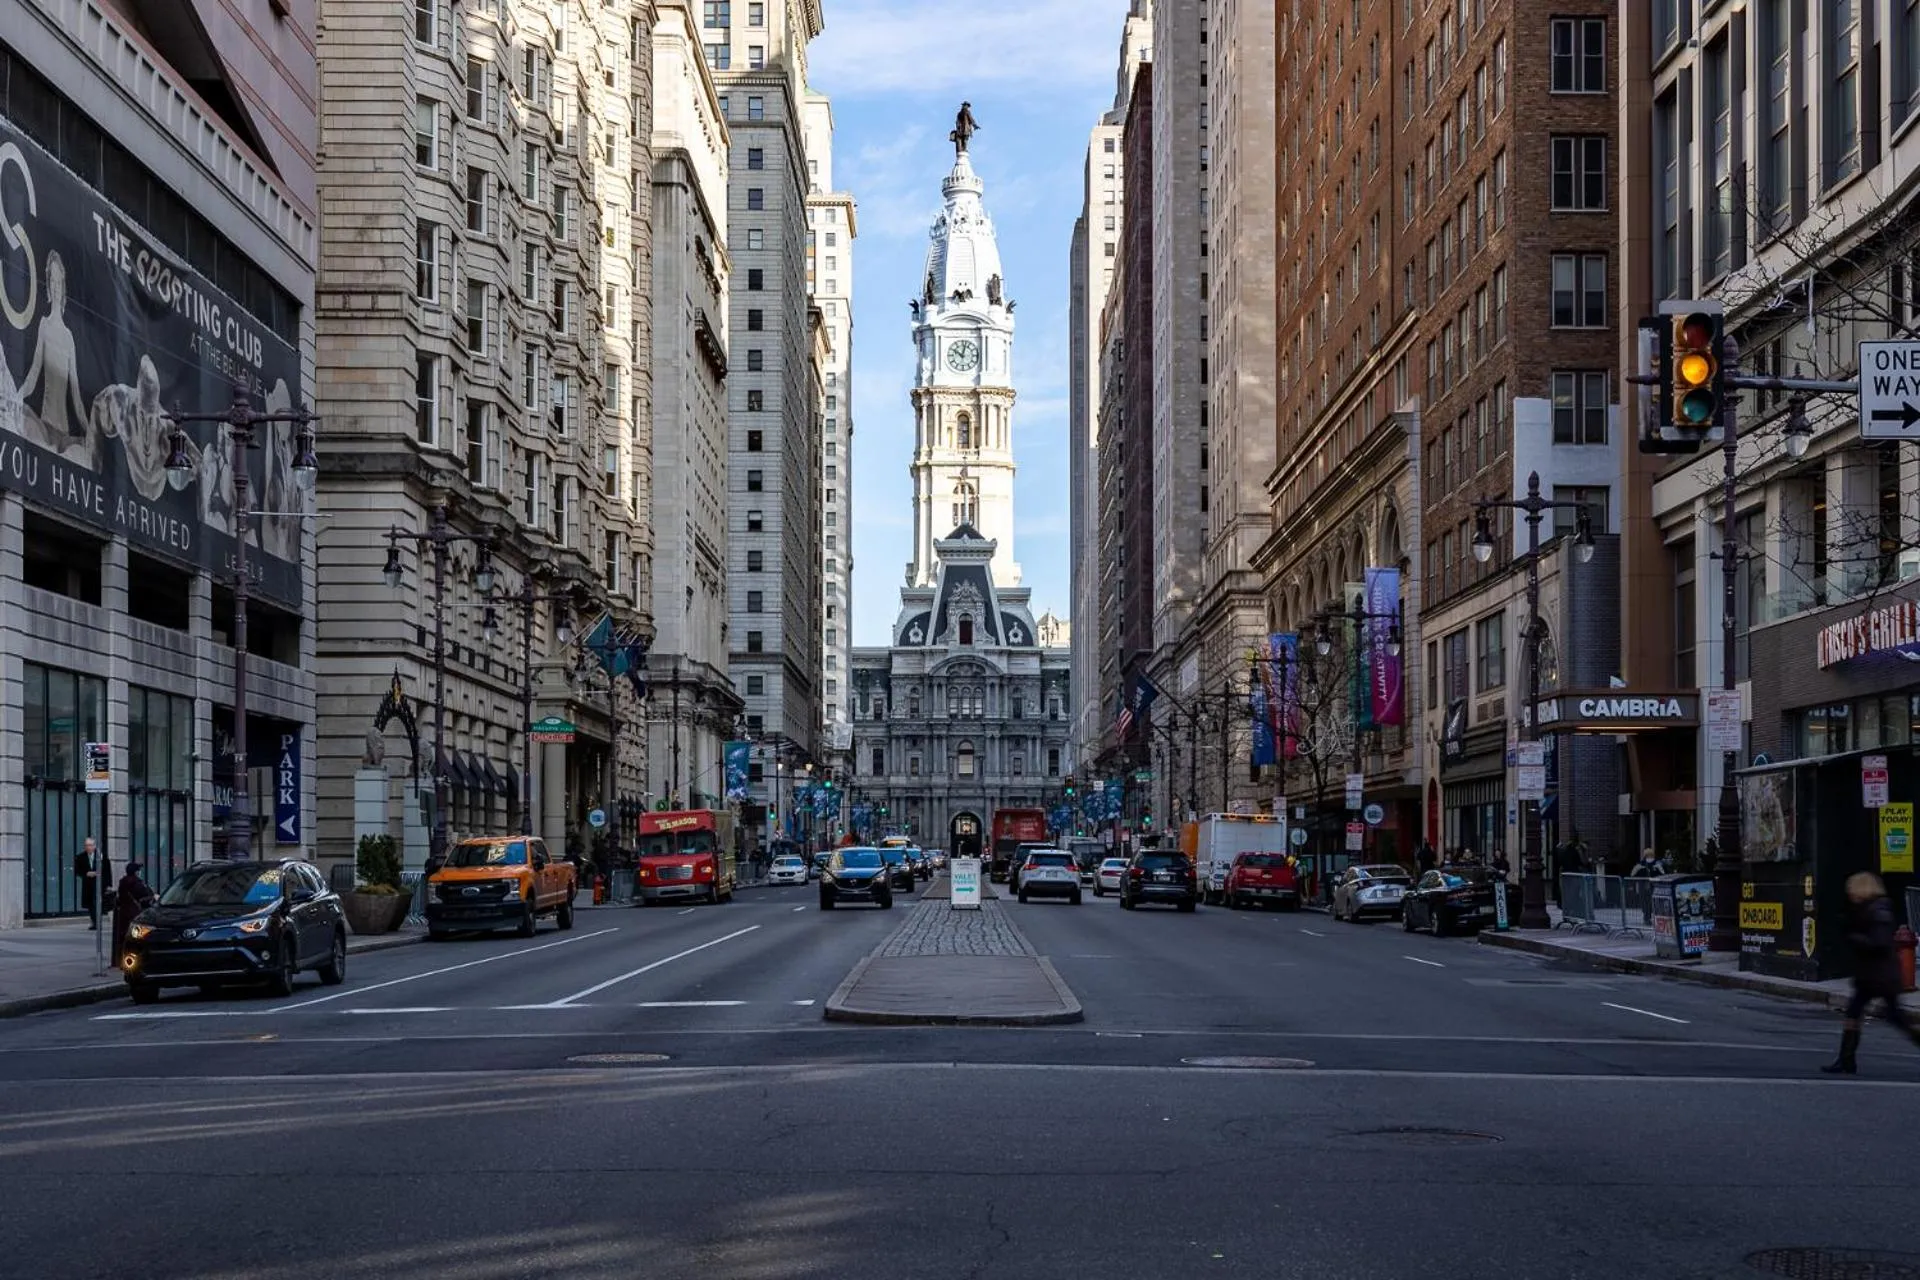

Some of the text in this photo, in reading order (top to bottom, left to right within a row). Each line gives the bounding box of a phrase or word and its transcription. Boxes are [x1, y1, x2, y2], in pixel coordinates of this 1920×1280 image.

[92, 211, 263, 369] THE SPORTING CLUB
[189, 332, 204, 356] AT
[1875, 350, 1920, 370] ONE
[1873, 376, 1920, 396] WAY
[51, 464, 105, 515] HAVE
[115, 495, 191, 551] ARRIVED
[1373, 634, 1388, 702] CREATIVITY
[279, 733, 297, 805] PARK
[1880, 816, 1912, 824] TODAY!
[1885, 807, 1908, 815] PLAY
